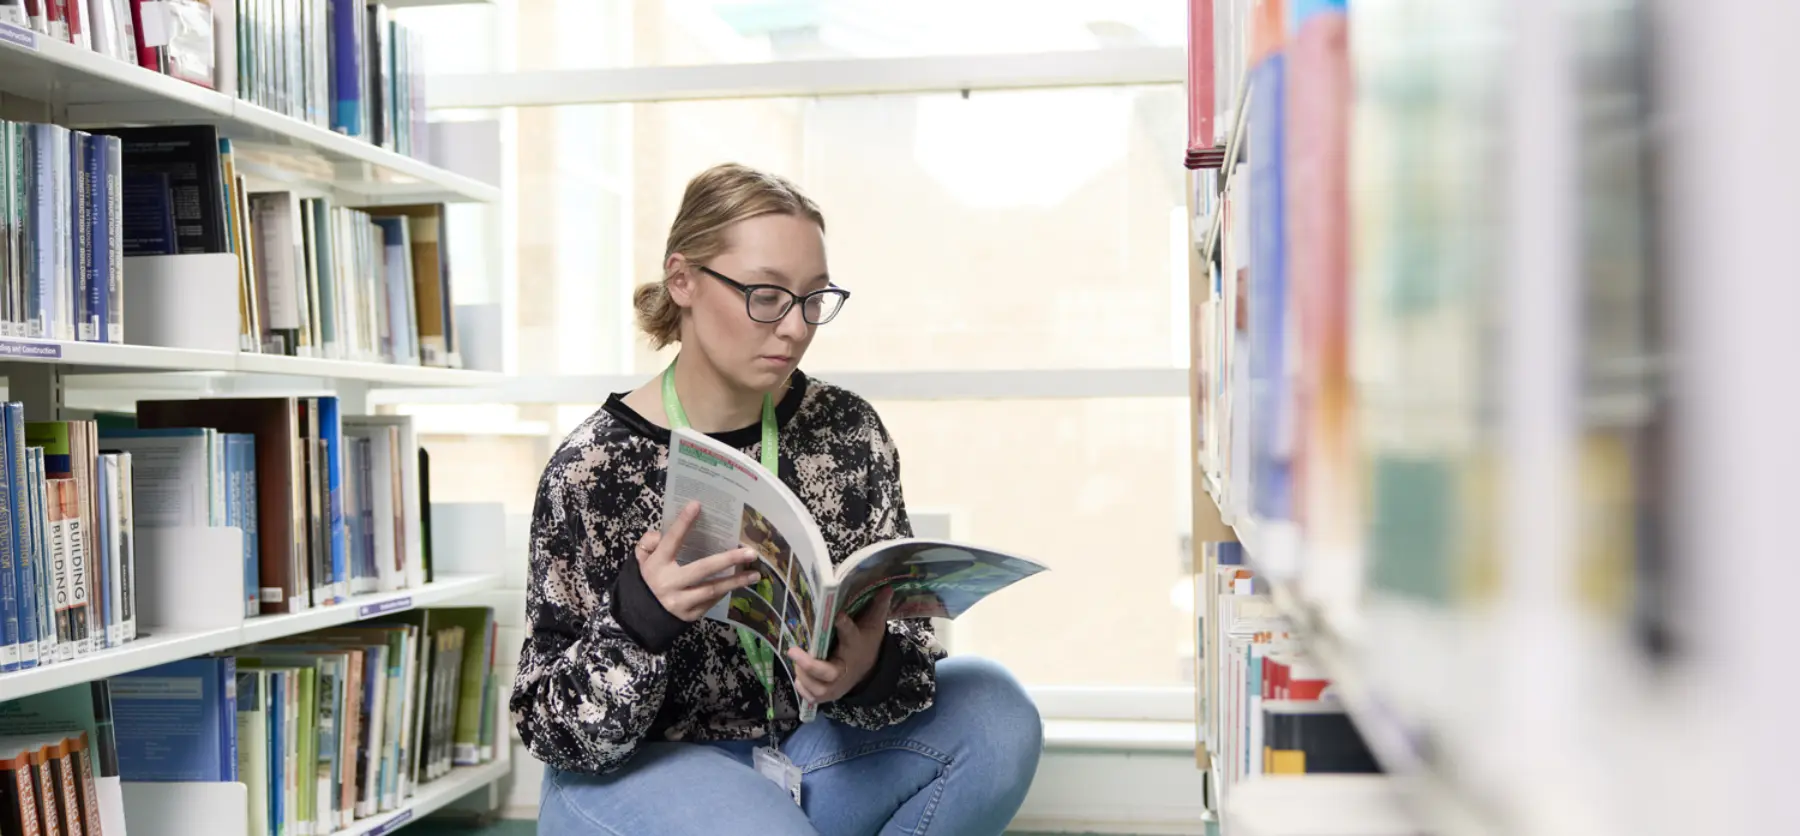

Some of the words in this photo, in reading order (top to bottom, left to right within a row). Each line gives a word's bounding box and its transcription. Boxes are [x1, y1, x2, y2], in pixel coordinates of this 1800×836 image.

[78, 170, 86, 233] CONSTRUCTION
[22, 345, 57, 356] Construction
[17, 489, 29, 568] CONSTRUCTION
[69, 521, 85, 601] BUILDING
[52, 524, 67, 605] BUILDING
[21, 763, 39, 832] SETTING
[43, 760, 59, 828] SETTING
[63, 753, 80, 820] SETTING
